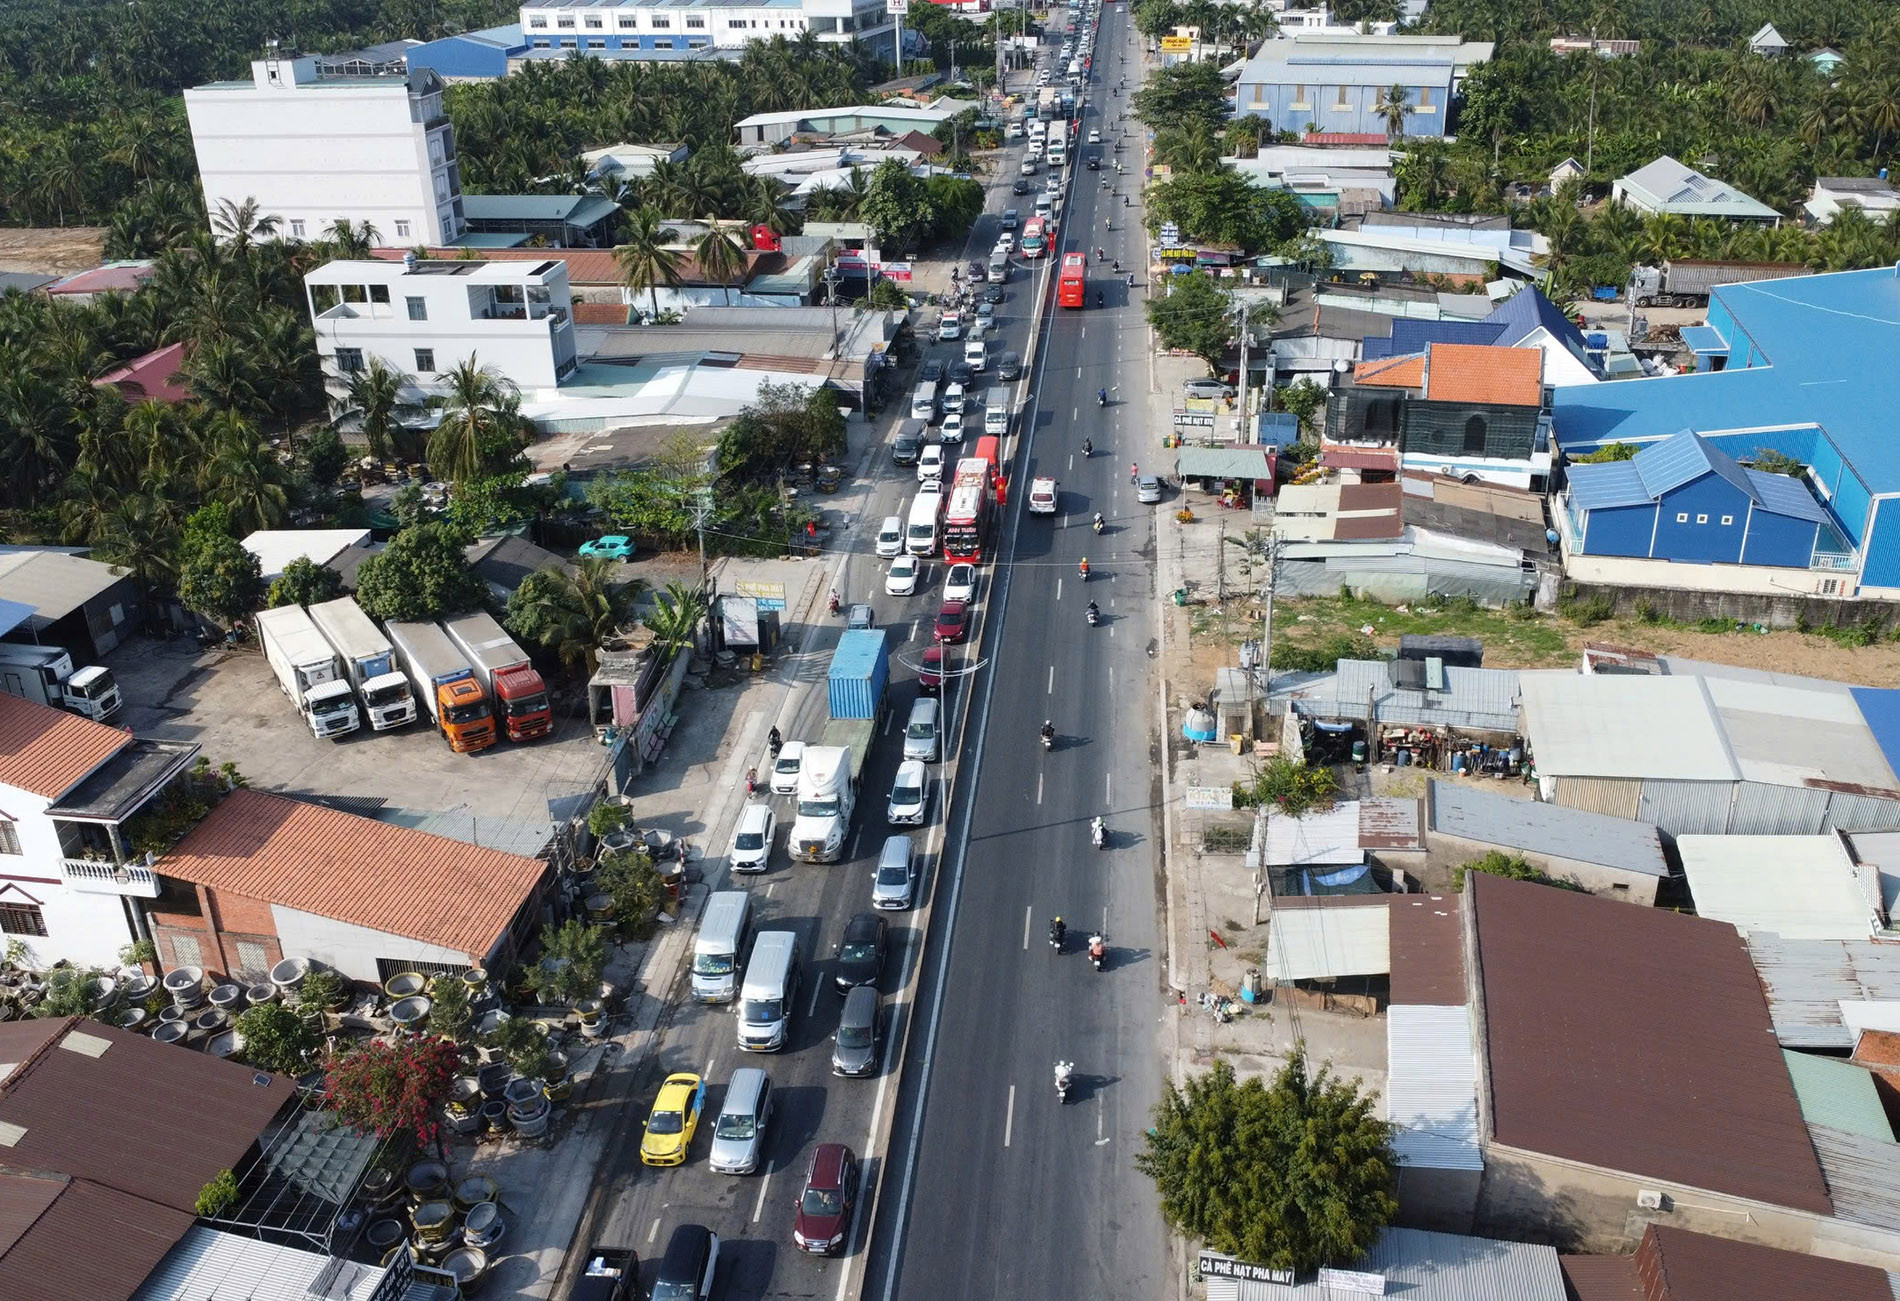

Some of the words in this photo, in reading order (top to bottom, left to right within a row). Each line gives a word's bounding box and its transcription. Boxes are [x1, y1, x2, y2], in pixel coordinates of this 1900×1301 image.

[1200, 1257, 1213, 1272] CÀ
[1214, 1261, 1231, 1276] PHÊ
[1233, 1264, 1251, 1280] HẠT
[1252, 1266, 1270, 1281] PHA
